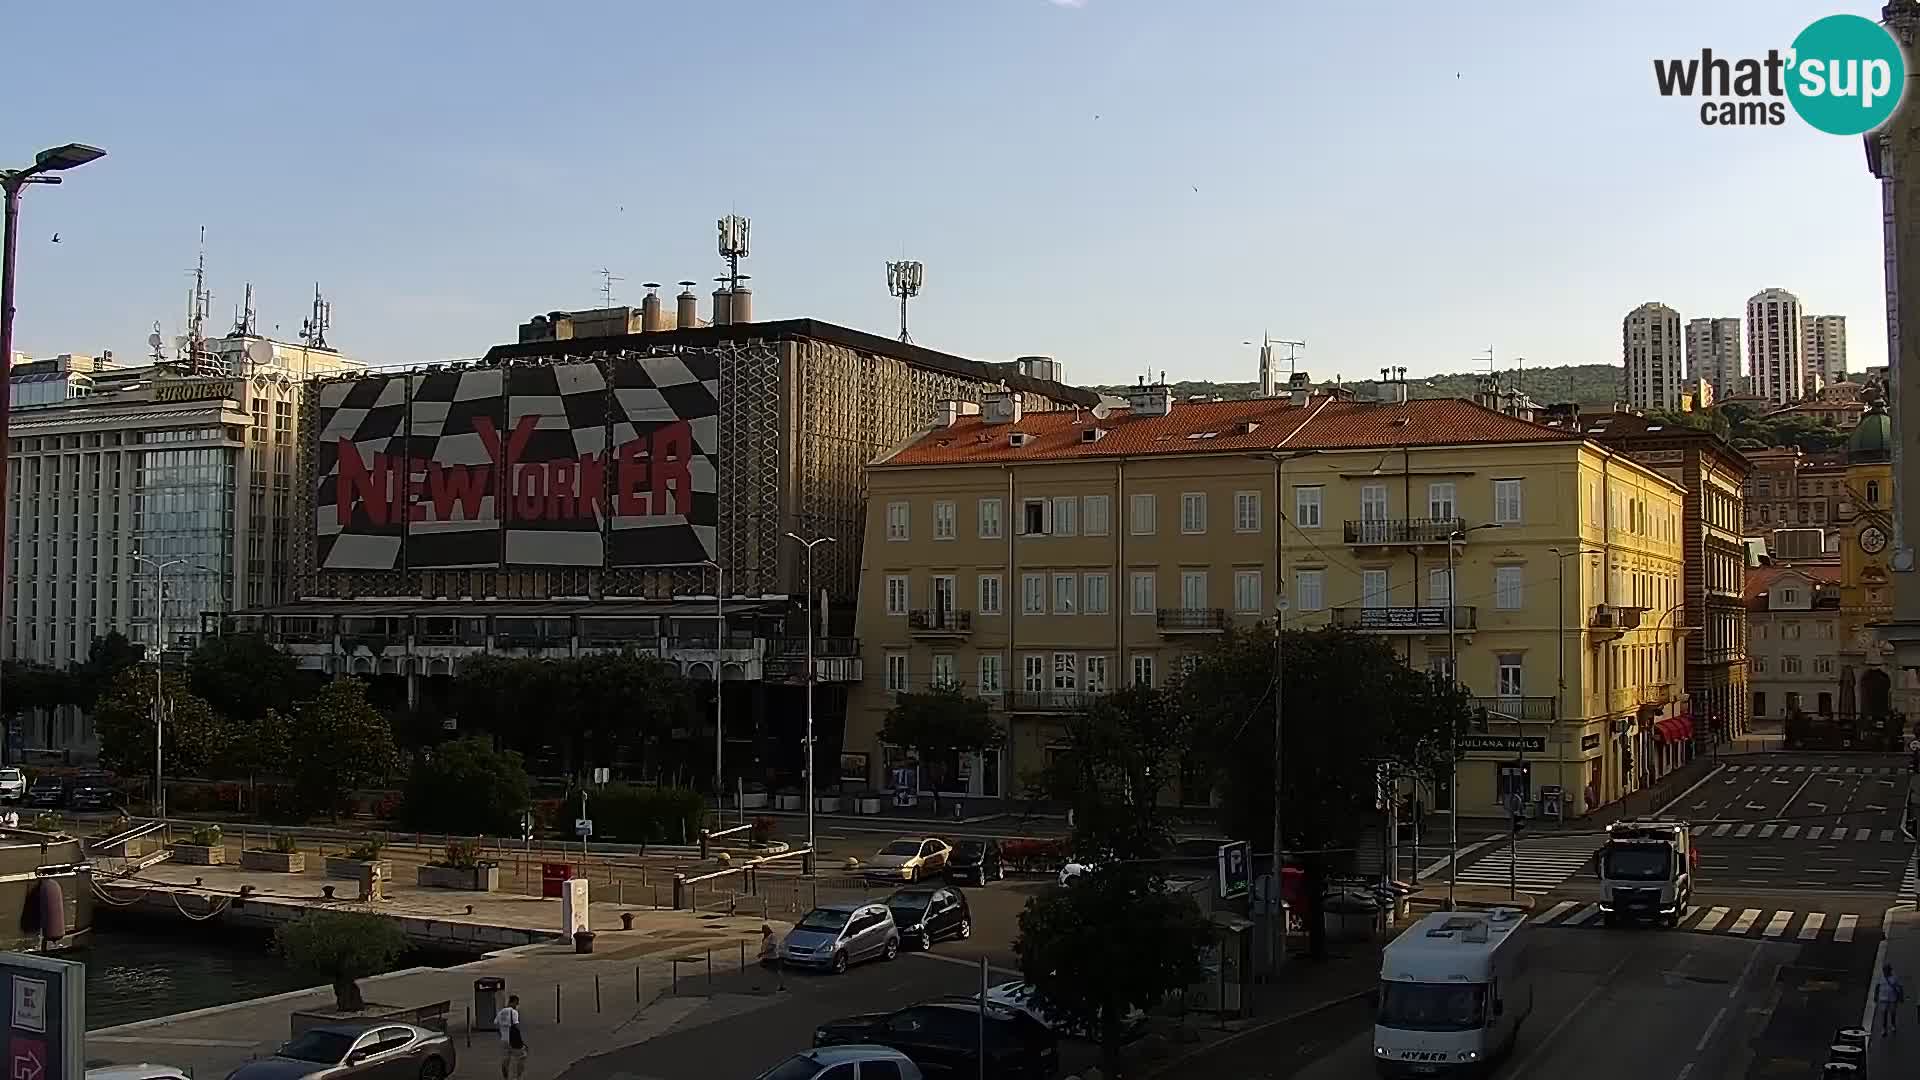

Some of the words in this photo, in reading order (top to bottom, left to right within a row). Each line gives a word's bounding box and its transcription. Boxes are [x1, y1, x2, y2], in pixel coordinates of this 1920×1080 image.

[336, 435, 490, 527] NEW
[471, 414, 693, 521] YORKER
[1457, 738, 1504, 748] JULIANA
[1507, 740, 1540, 749] NAILS
[1230, 850, 1242, 874] P
[1400, 1050, 1448, 1062] HYMER
